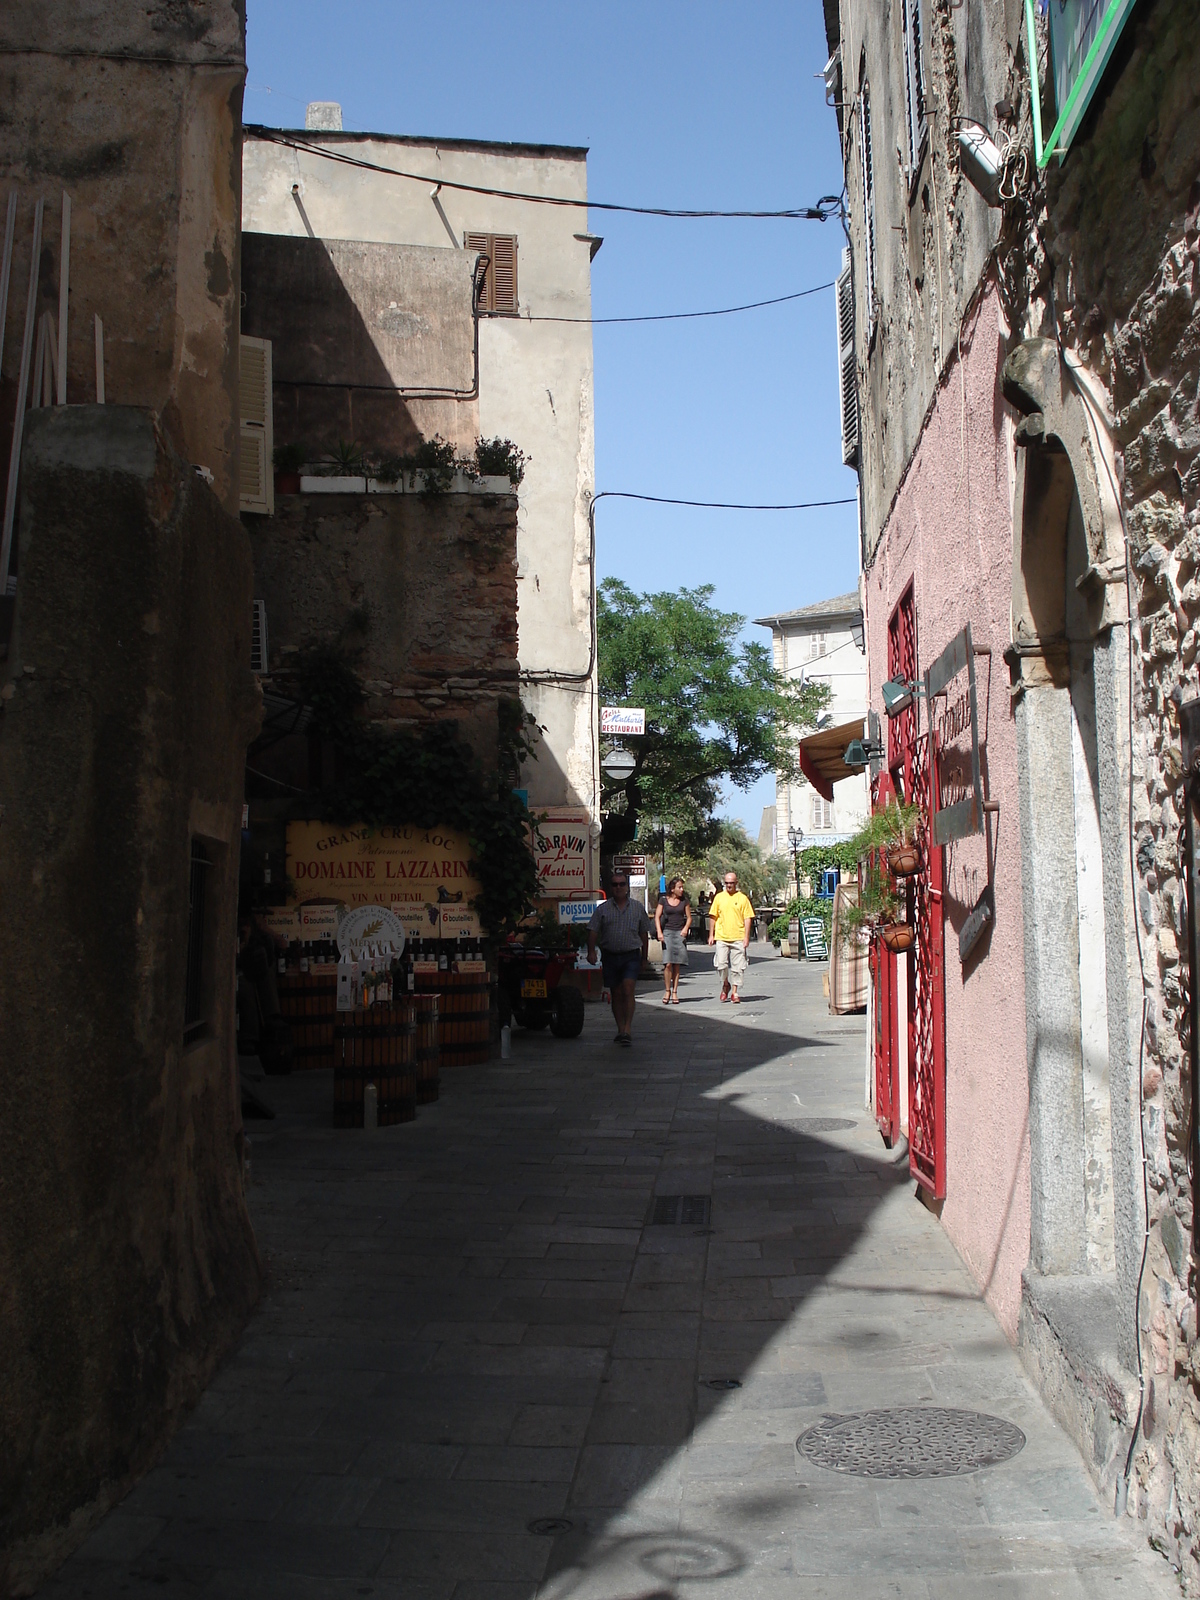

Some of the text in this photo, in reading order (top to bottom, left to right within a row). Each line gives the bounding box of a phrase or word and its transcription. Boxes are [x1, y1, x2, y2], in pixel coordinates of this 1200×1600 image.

[602, 724, 642, 733] RESTAURANT
[380, 827, 414, 840] CRU
[420, 833, 455, 851] AOC
[358, 844, 416, 856] Patrimonio
[554, 848, 568, 862] Le
[295, 861, 376, 879] DOMAINE
[539, 864, 585, 877] Mathurin
[352, 892, 425, 902] VIN AU DETAIL
[267, 917, 294, 926] bouteilles
[303, 915, 309, 925] 6
[310, 916, 336, 925] bouteilles
[398, 913, 424, 922] bouteilles
[442, 912, 474, 923] 6 bouteilles
